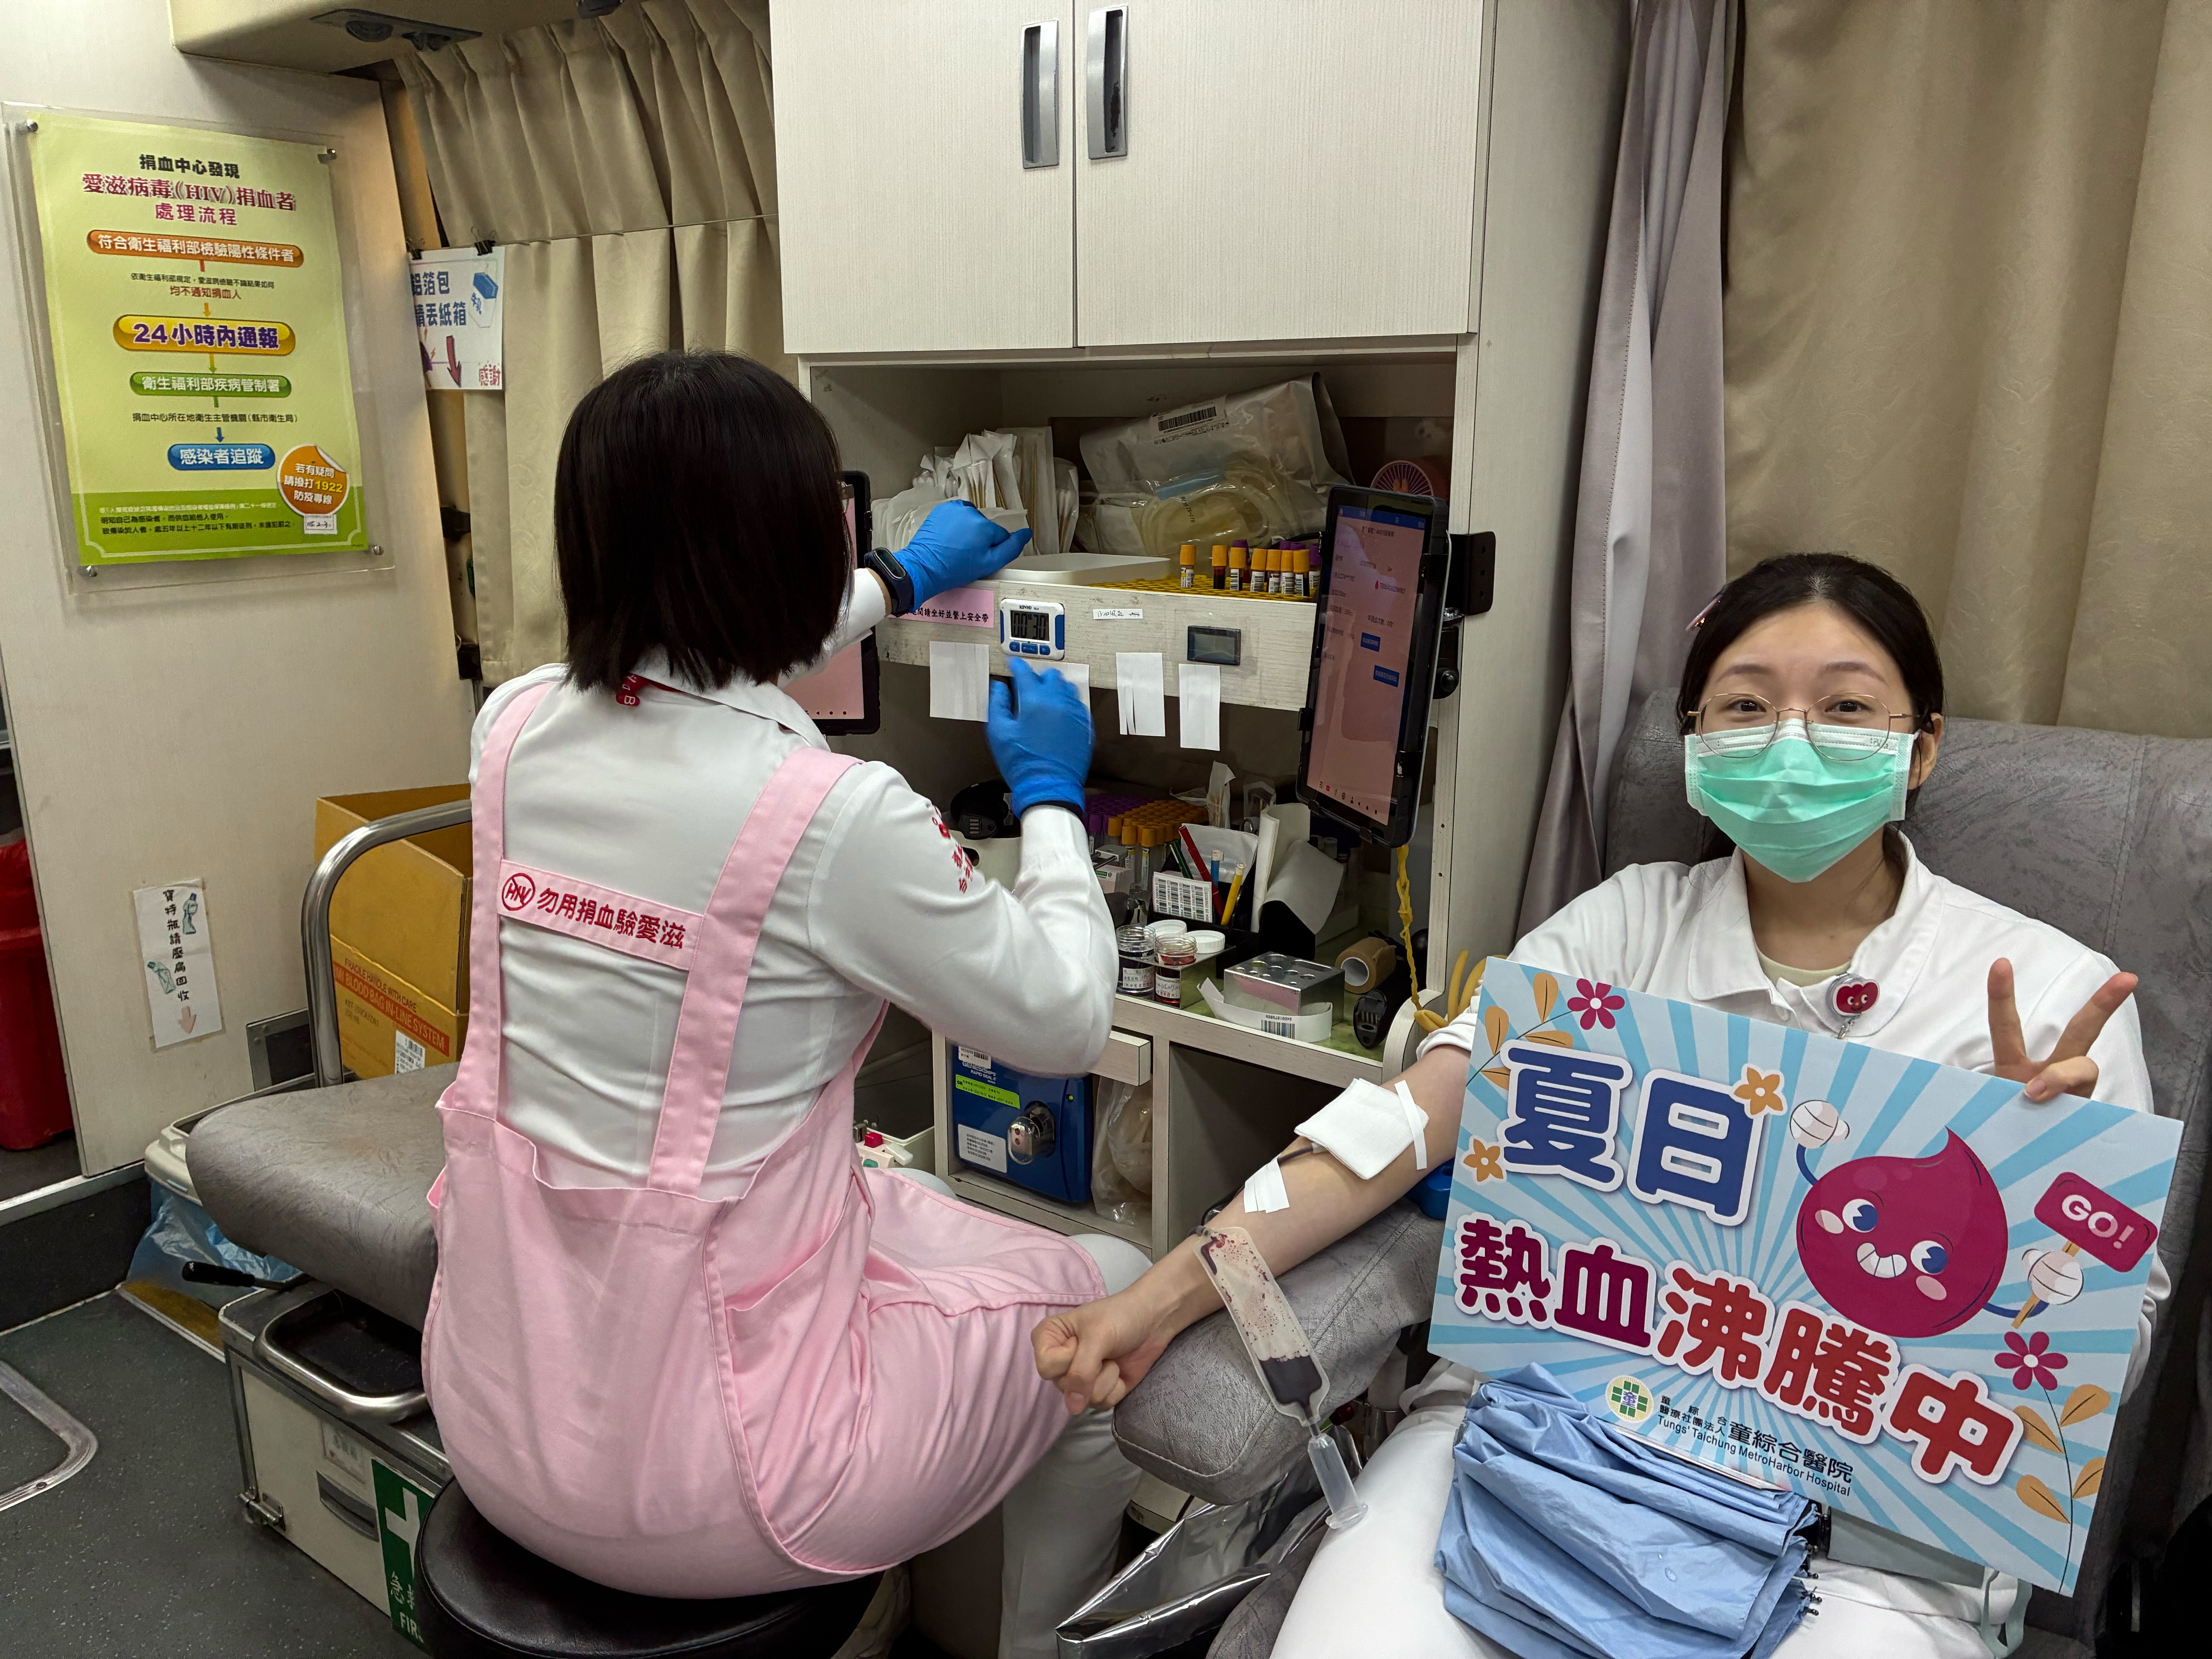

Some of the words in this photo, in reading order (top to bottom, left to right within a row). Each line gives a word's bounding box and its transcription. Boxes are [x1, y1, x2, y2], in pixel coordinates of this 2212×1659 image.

[139, 154, 240, 179] 捐血中心發現
[155, 203, 237, 226] 處理流程
[98, 234, 294, 263] 符合衛生福利部檢驗陽性條件者
[170, 285, 242, 300] 均不通知捐血人
[133, 323, 280, 349] 24小時內通報
[142, 376, 280, 392] 衛生福利部疾病管制署
[479, 363, 501, 386] 感謝
[180, 448, 264, 465] 感染者追蹤
[295, 463, 335, 479] 若有疑問
[294, 490, 332, 505] 防疫專線
[537, 888, 686, 949] 勿用捐血驗愛滋
[163, 890, 190, 1002] 寶特瓶請壓扁回收
[345, 972, 369, 998] BLOOD
[369, 989, 385, 1010] BAG
[413, 1018, 445, 1050] SYSTEM
[387, 986, 401, 1003] WITH
[402, 997, 417, 1013] CARE
[1505, 1047, 1756, 1218] 夏日
[2060, 1193, 2133, 1250] GO!
[1462, 1218, 2022, 1478] 熱血沸騰中
[1660, 1404, 1725, 1437] 醫療社團法人
[1658, 1414, 1690, 1434] Tungs'
[1692, 1427, 1737, 1456] Taichung
[1739, 1445, 1805, 1478] MetroHarbor
[1806, 1471, 1851, 1497] Hospital
[1728, 1420, 1853, 1484] 童綜合醫院
[399, 1611, 424, 1644] FIR
